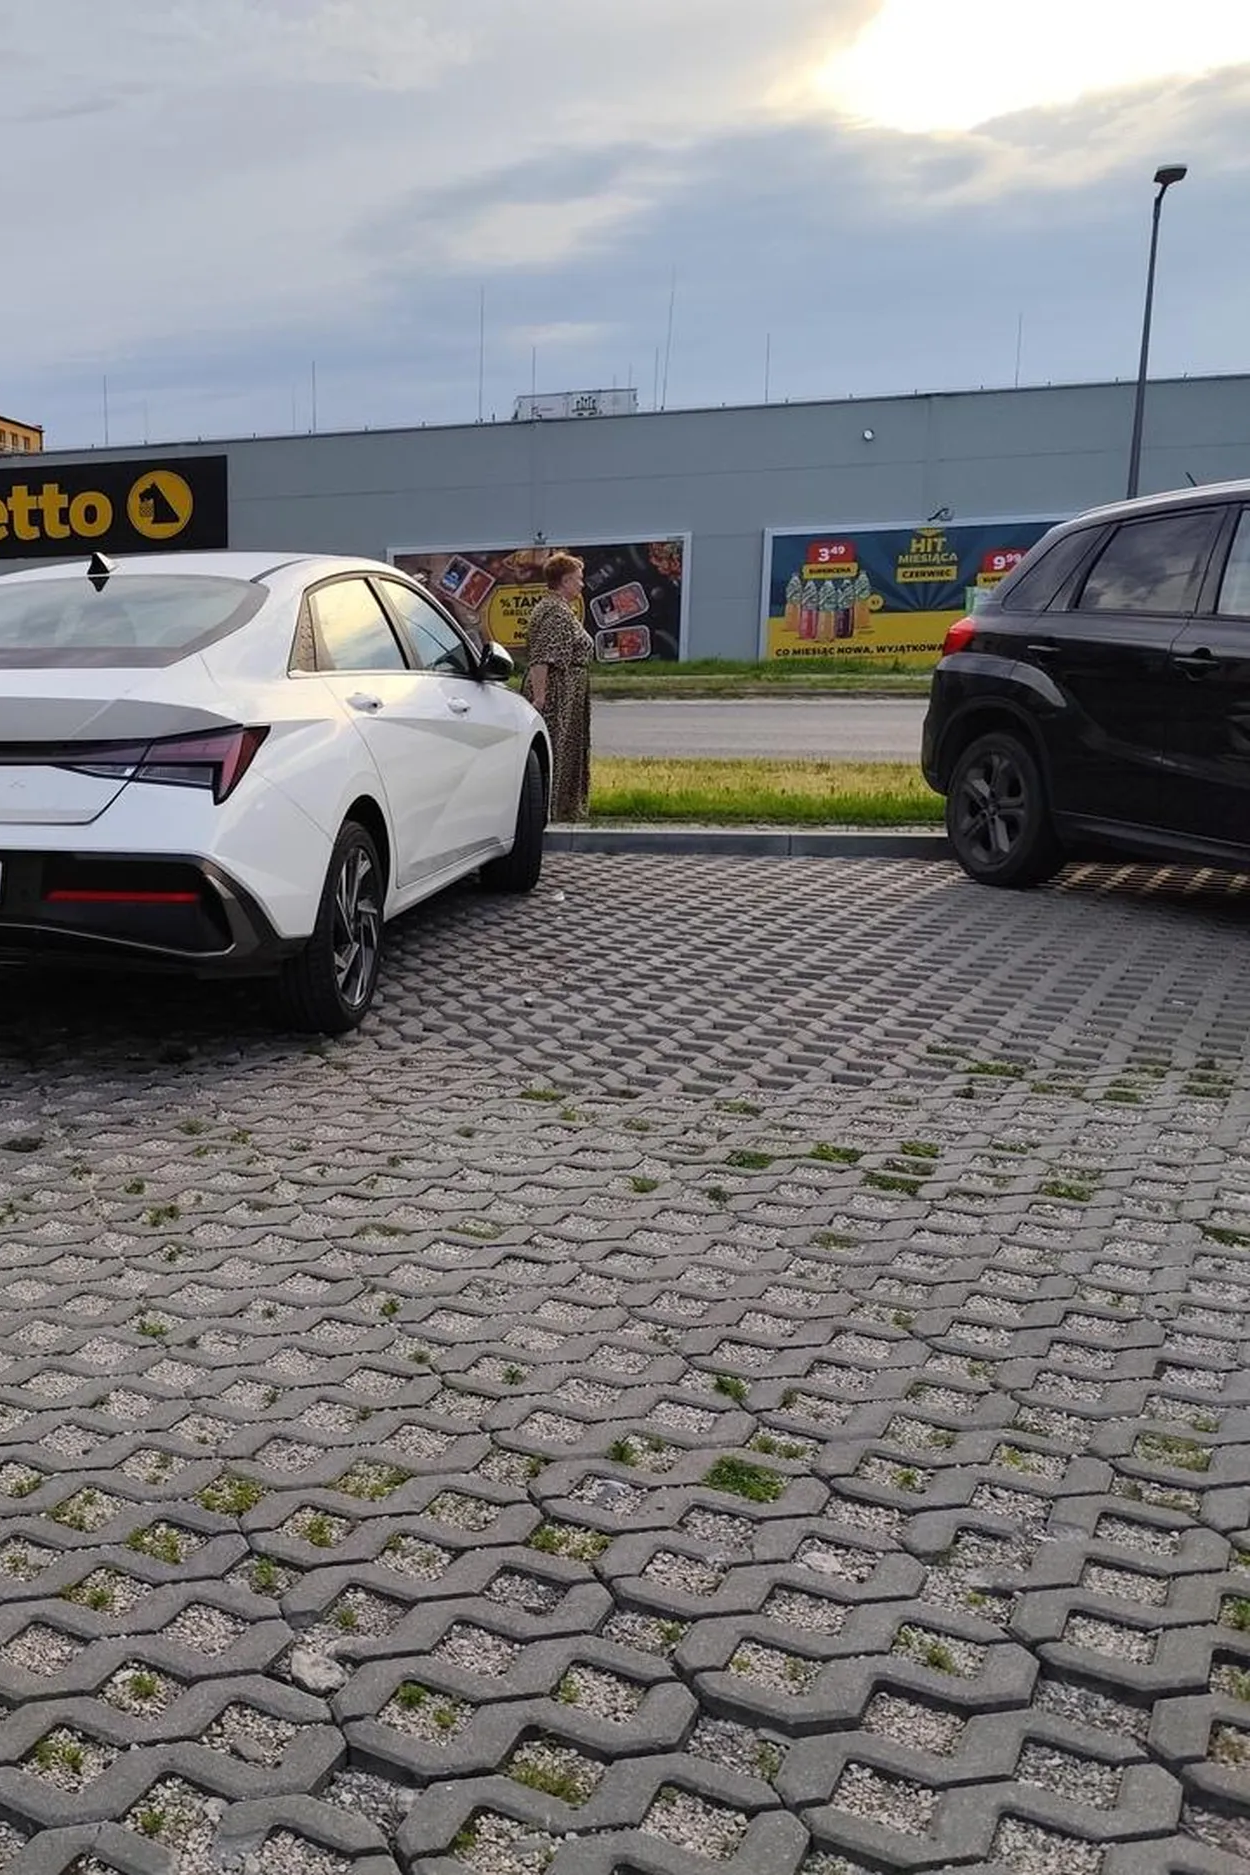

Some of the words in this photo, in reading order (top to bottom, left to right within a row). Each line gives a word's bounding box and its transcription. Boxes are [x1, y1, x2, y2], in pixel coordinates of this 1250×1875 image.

[910, 536, 948, 553] HIT
[817, 545, 846, 562] 349
[897, 552, 959, 565] MIESIĄCA
[902, 569, 953, 580] CZERWIEC
[775, 647, 791, 657] CO
[792, 646, 835, 657] MIESIĄC
[837, 645, 875, 656] NOWA,
[876, 643, 945, 655] WYJĄTKOWA
